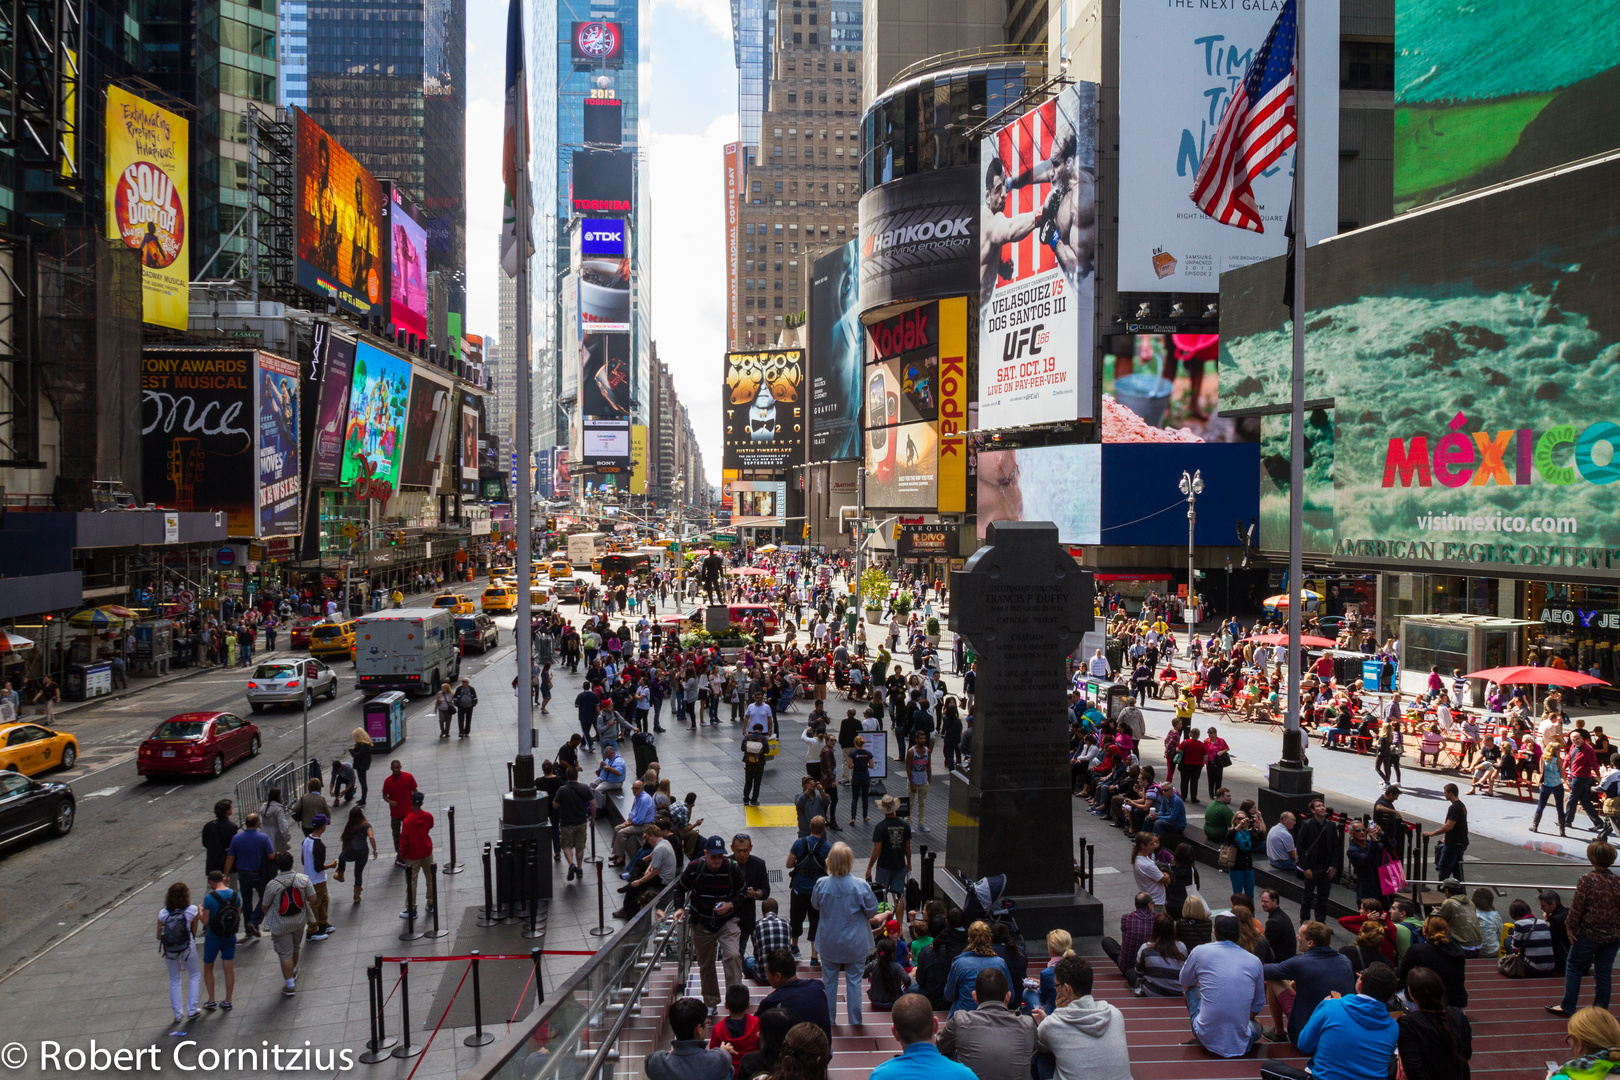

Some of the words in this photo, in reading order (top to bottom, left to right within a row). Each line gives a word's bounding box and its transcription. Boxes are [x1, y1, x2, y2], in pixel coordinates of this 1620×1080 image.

[1168, 0, 1194, 8] THE
[1200, 0, 1234, 9] NEXT
[1194, 35, 1258, 76] TIM
[590, 89, 615, 98] 2013
[125, 164, 177, 213] SOUL
[574, 200, 631, 210] TOSHIBA
[128, 201, 177, 234] DOCTOR
[593, 232, 621, 242] TDK
[884, 244, 916, 258] driving
[918, 238, 970, 250] emotion
[992, 283, 1050, 315] VELASQUEZ
[1052, 278, 1064, 296] VS
[989, 314, 1007, 333] DOS
[1010, 301, 1051, 327] SANTOS
[1054, 296, 1066, 314] III
[871, 308, 928, 360] Kodak
[1003, 324, 1044, 362] UFC
[1036, 332, 1050, 345] 166
[142, 359, 179, 371] TONY
[181, 360, 247, 372] AWARDS
[997, 365, 1018, 382] SAT.
[1020, 360, 1040, 378] OCT.
[1044, 356, 1056, 373] 19
[142, 375, 169, 388] EST
[174, 376, 247, 389] MUSICAL
[988, 384, 1002, 396] LIVE
[1004, 382, 1013, 393] ON
[1015, 372, 1067, 390] PAY-PER-VIEW
[814, 404, 837, 414] GRAVITY
[941, 356, 964, 458] Kodak
[727, 424, 800, 434] 20/20
[260, 452, 283, 475] MOVES
[260, 475, 298, 507] NEWSIES
[354, 454, 392, 516] Disney
[1417, 511, 1578, 534] visitmexico.com
[921, 533, 945, 541] DIVO
[1334, 538, 1436, 561] AMERICAN
[1442, 542, 1514, 564] EAGLE
[986, 594, 1024, 603] FRANCIS
[1037, 594, 1069, 603] DUFFY
[1540, 609, 1574, 624] AEO
